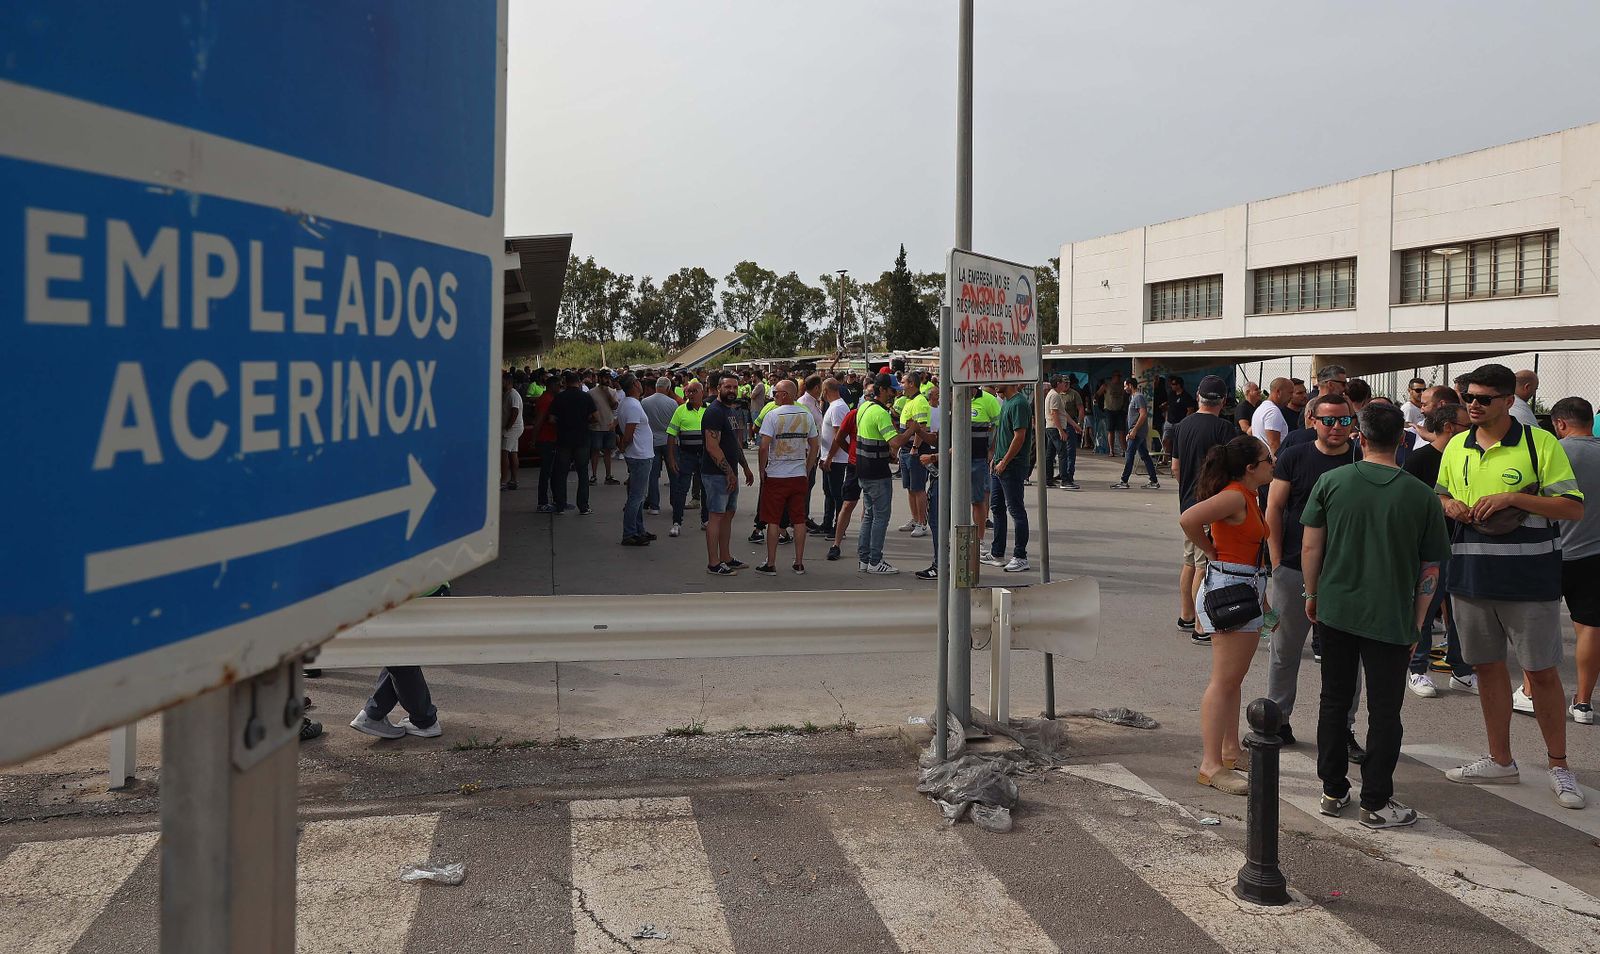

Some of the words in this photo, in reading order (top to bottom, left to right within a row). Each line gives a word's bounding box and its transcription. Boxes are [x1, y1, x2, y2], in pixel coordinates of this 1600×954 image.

[24, 206, 459, 340] EMPLEADOS
[958, 266, 966, 282] LA
[968, 268, 993, 287] EMPRESA
[994, 274, 1002, 289] NO
[1002, 276, 1010, 290] SE
[956, 297, 1004, 317] RESPONSABILIZA
[1004, 304, 1012, 318] DE
[954, 327, 966, 343] LOS
[92, 359, 438, 470] ACERINOX
